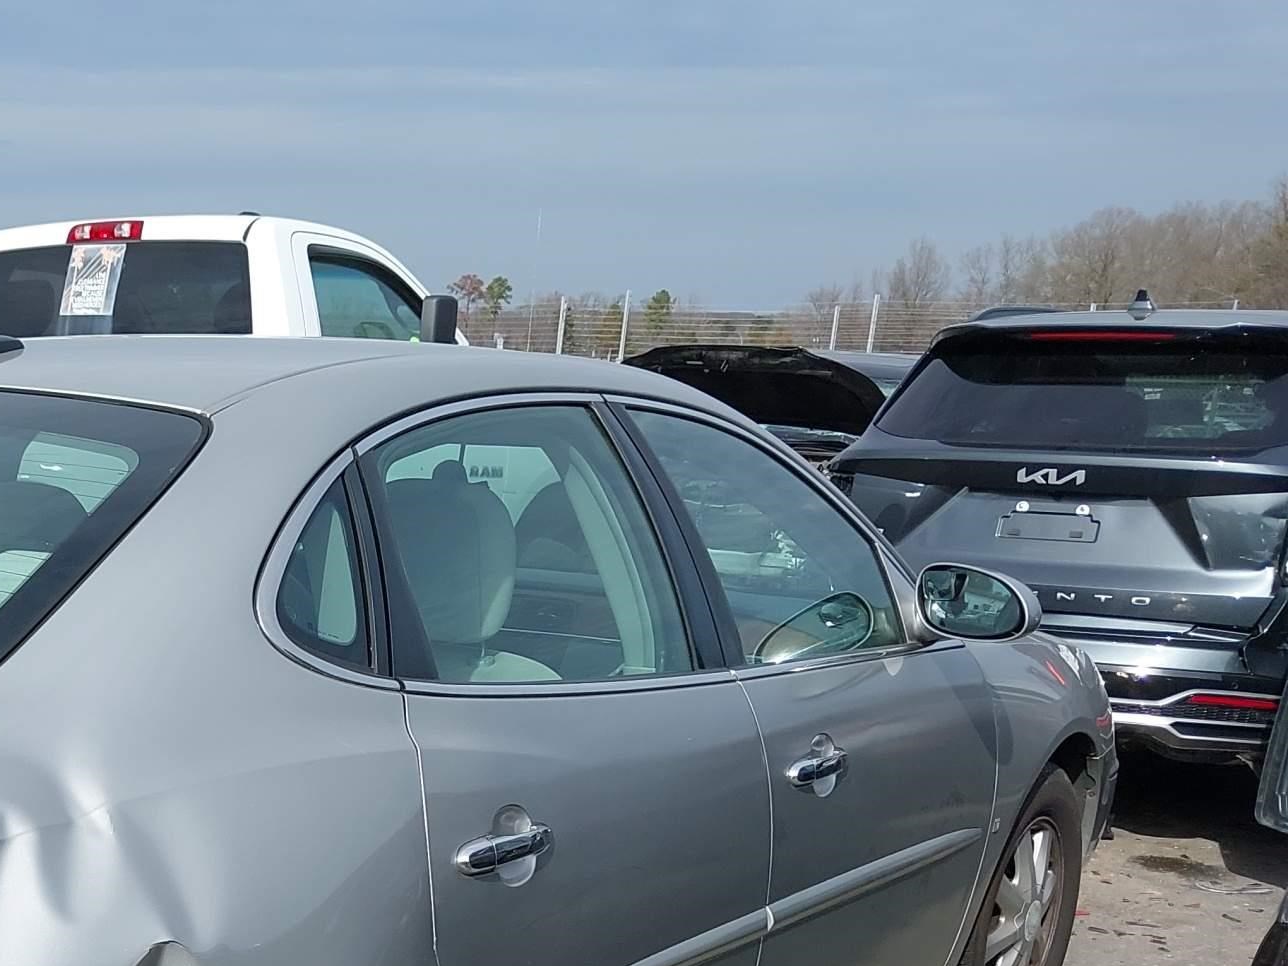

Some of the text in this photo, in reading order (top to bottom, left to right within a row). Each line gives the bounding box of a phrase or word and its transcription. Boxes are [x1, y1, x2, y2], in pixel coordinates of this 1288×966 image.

[469, 465, 504, 479] RAM
[1016, 467, 1086, 486] KIA
[1033, 590, 1152, 606] NTO
